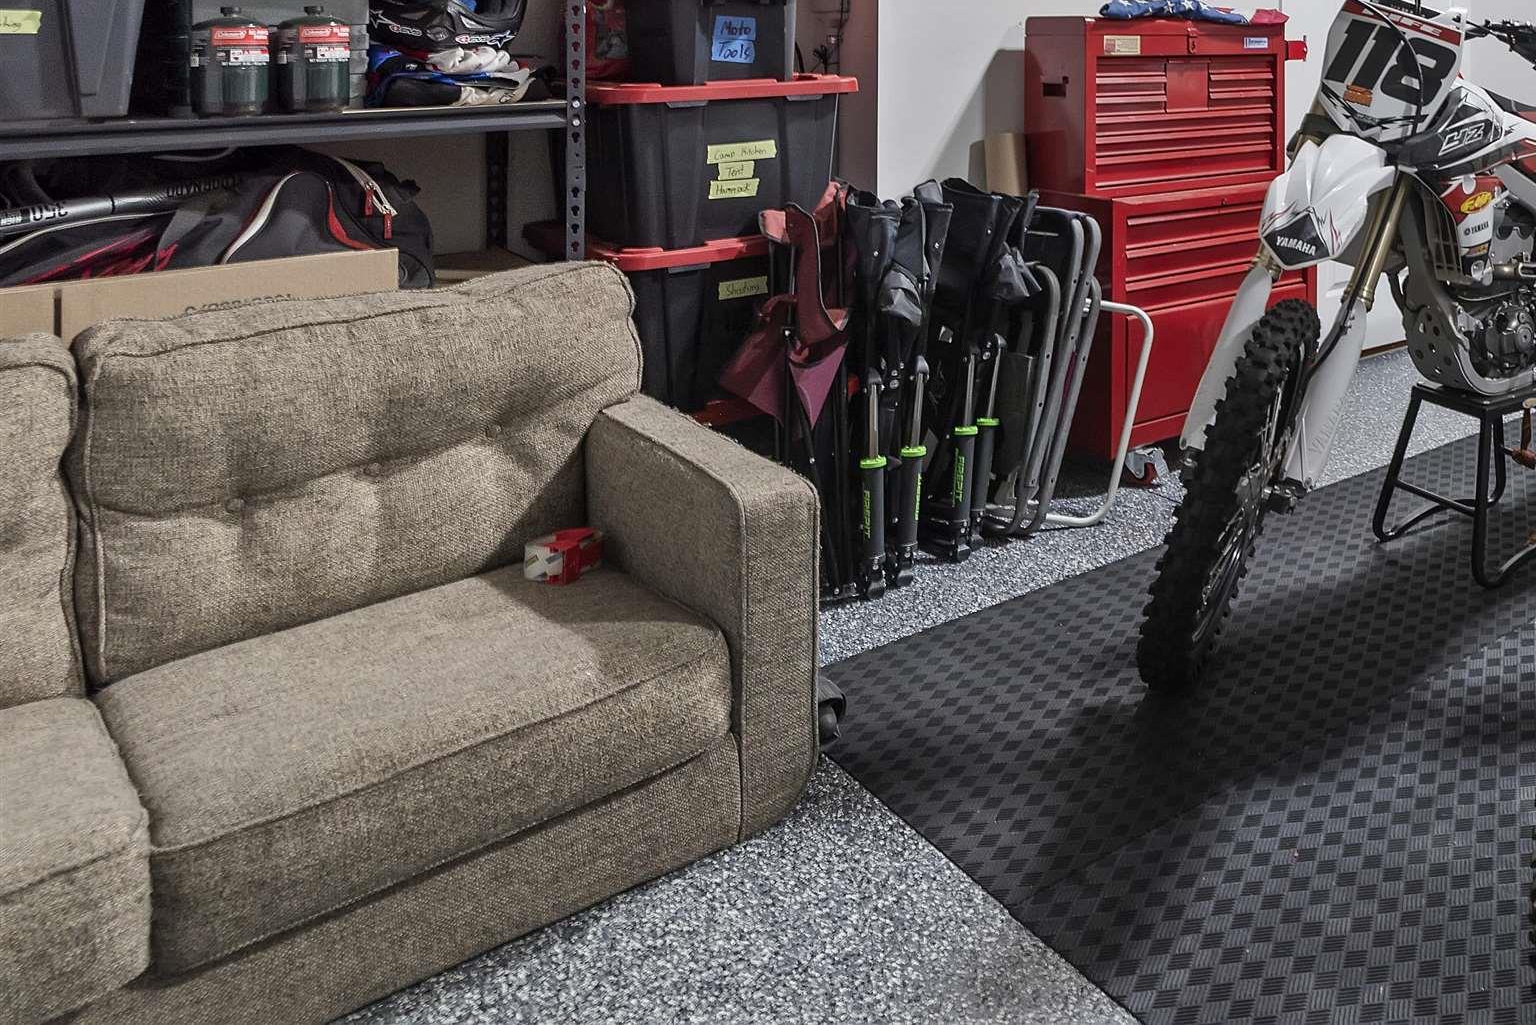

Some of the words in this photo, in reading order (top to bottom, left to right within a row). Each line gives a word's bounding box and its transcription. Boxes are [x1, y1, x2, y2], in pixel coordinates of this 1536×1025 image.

[720, 20, 752, 36] Moto
[719, 40, 752, 60] Tools
[1325, 19, 1457, 107] 118
[1276, 235, 1317, 256] YAMAHA
